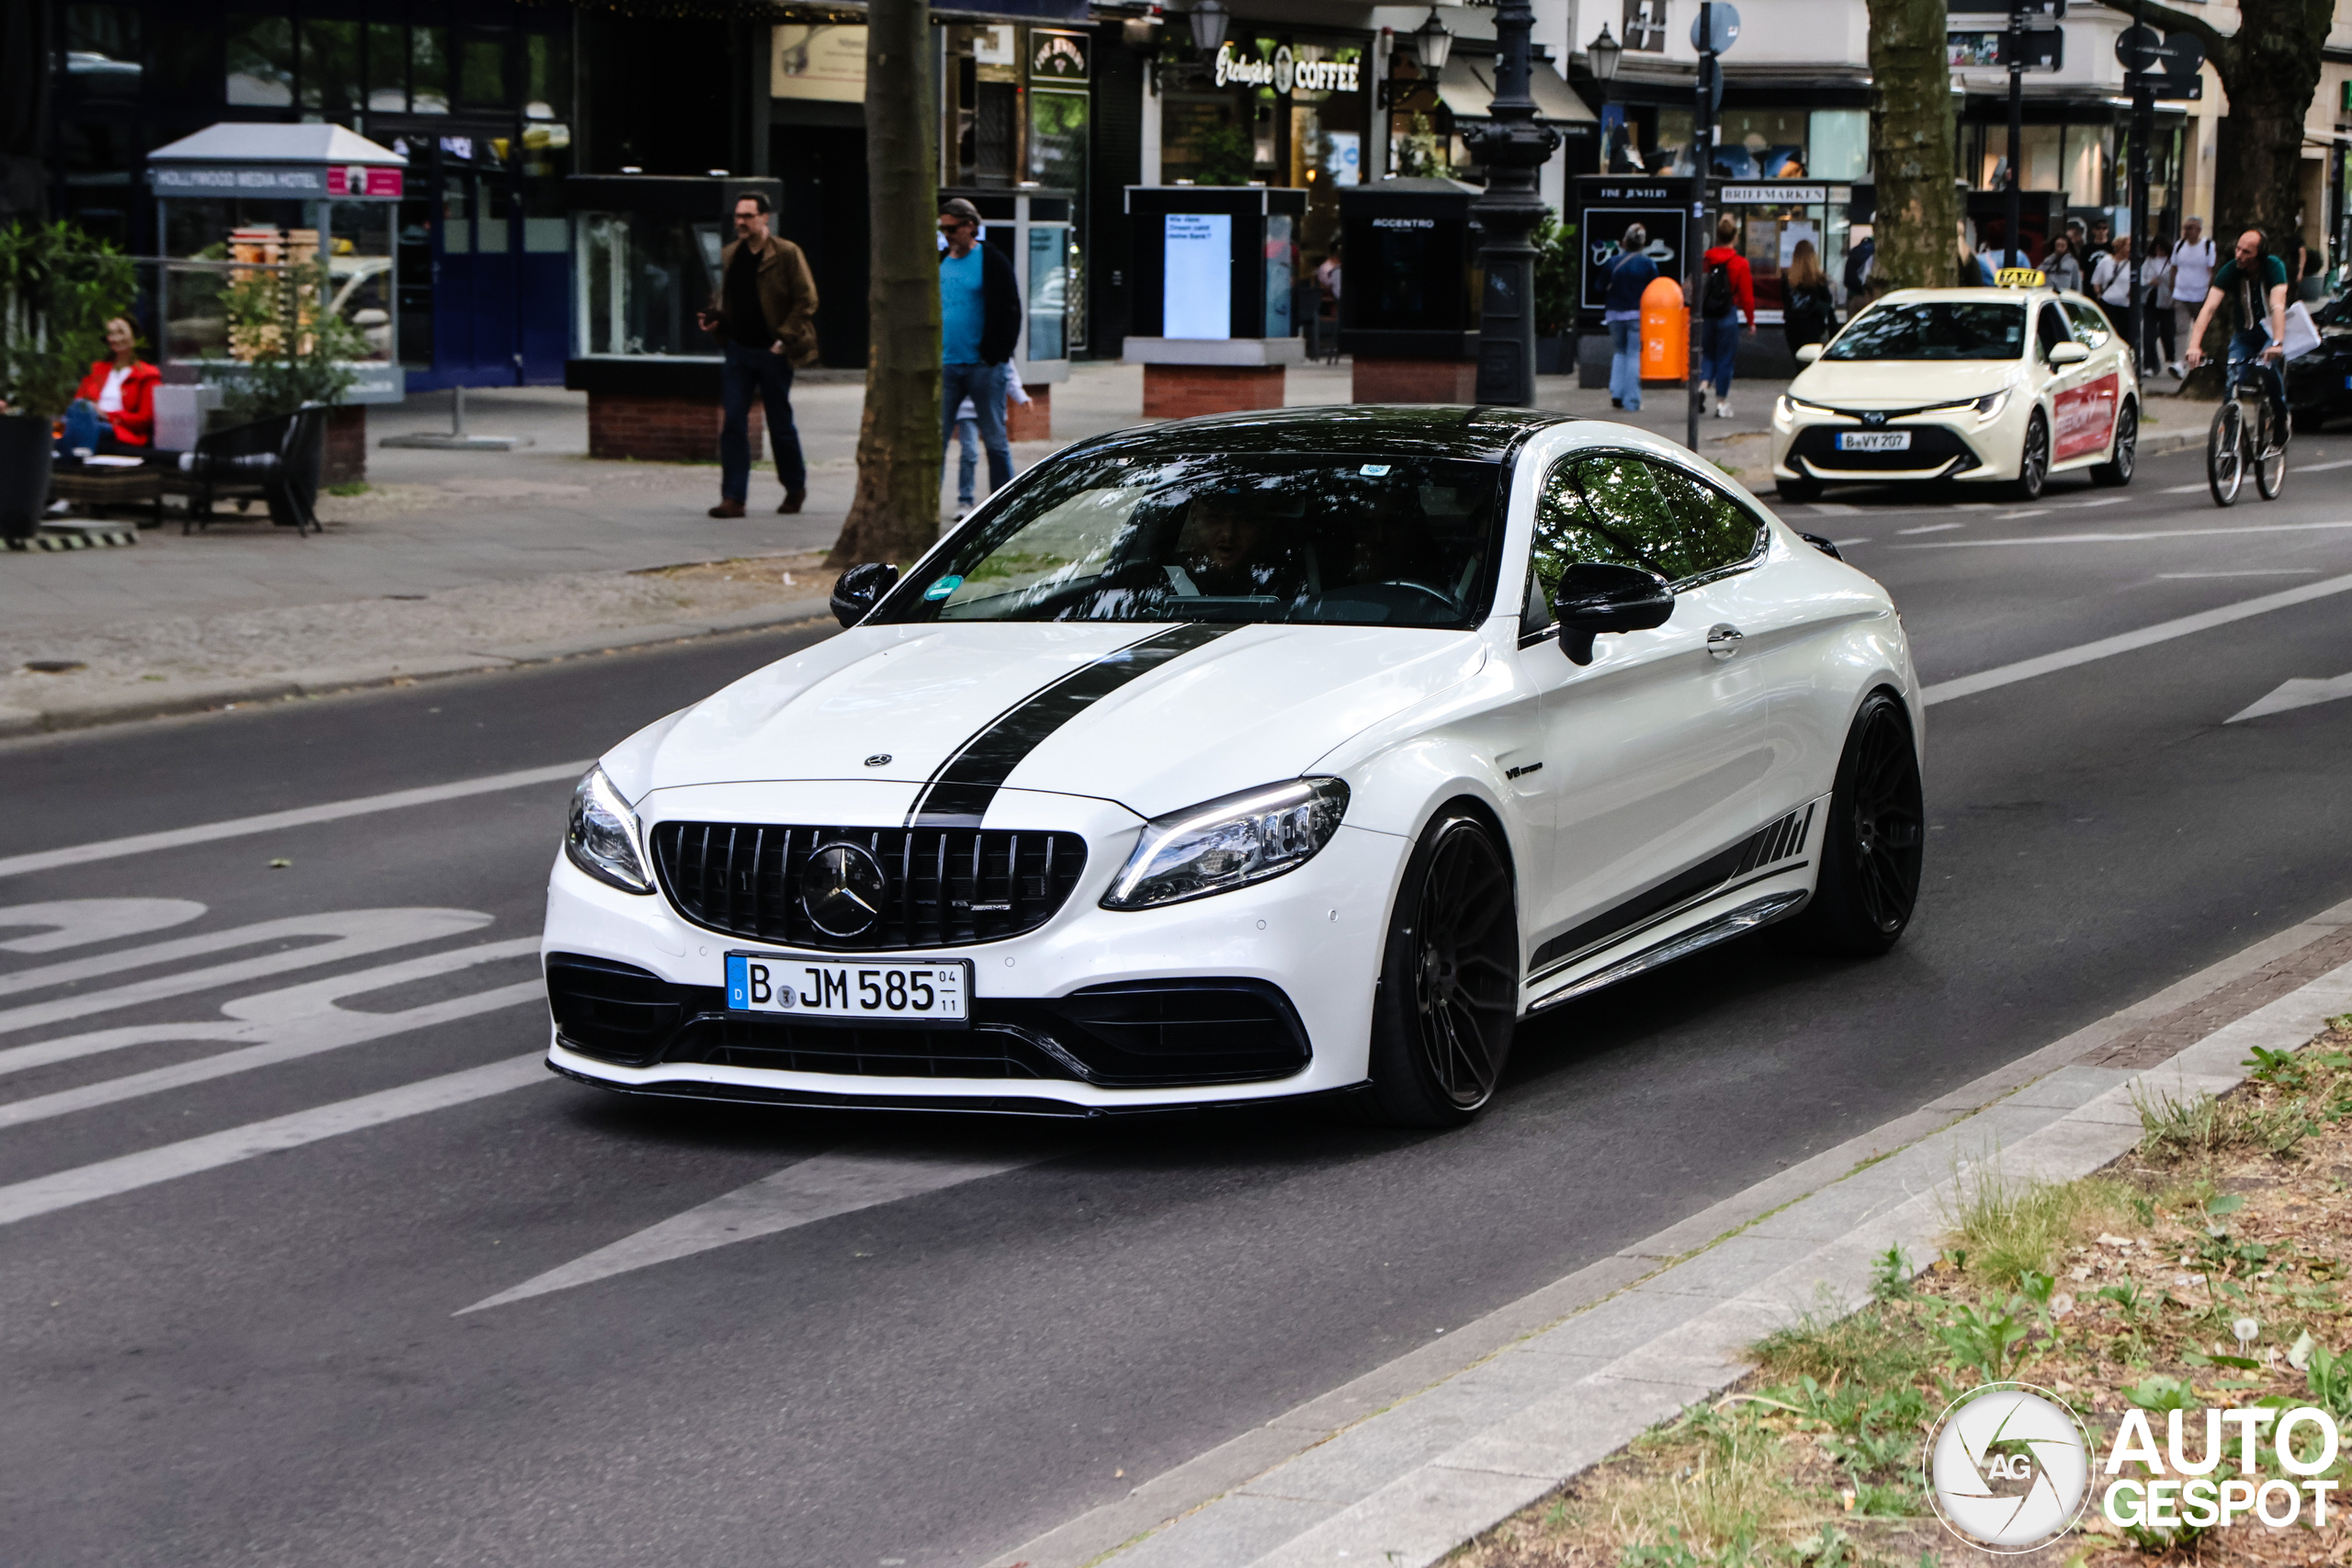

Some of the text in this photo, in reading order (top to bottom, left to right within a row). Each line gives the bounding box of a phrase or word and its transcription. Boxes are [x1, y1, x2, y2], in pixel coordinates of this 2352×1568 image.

[1295, 59, 1359, 92] COFFEE
[157, 171, 234, 186] HOLLYWOOD
[237, 172, 275, 186] MEDIA
[277, 173, 319, 187] HOTEL
[1624, 188, 1668, 199] JEWELRY
[1724, 189, 1823, 199] BRIEFMARKEN
[1372, 219, 1434, 228] ACCENTRO
[2001, 271, 2035, 284] TAXI
[1846, 435, 1904, 448] B VY 207
[938, 970, 956, 983] 04
[734, 987, 743, 1001] D
[750, 964, 935, 1012] B JM 585
[941, 999, 956, 1012] 11
